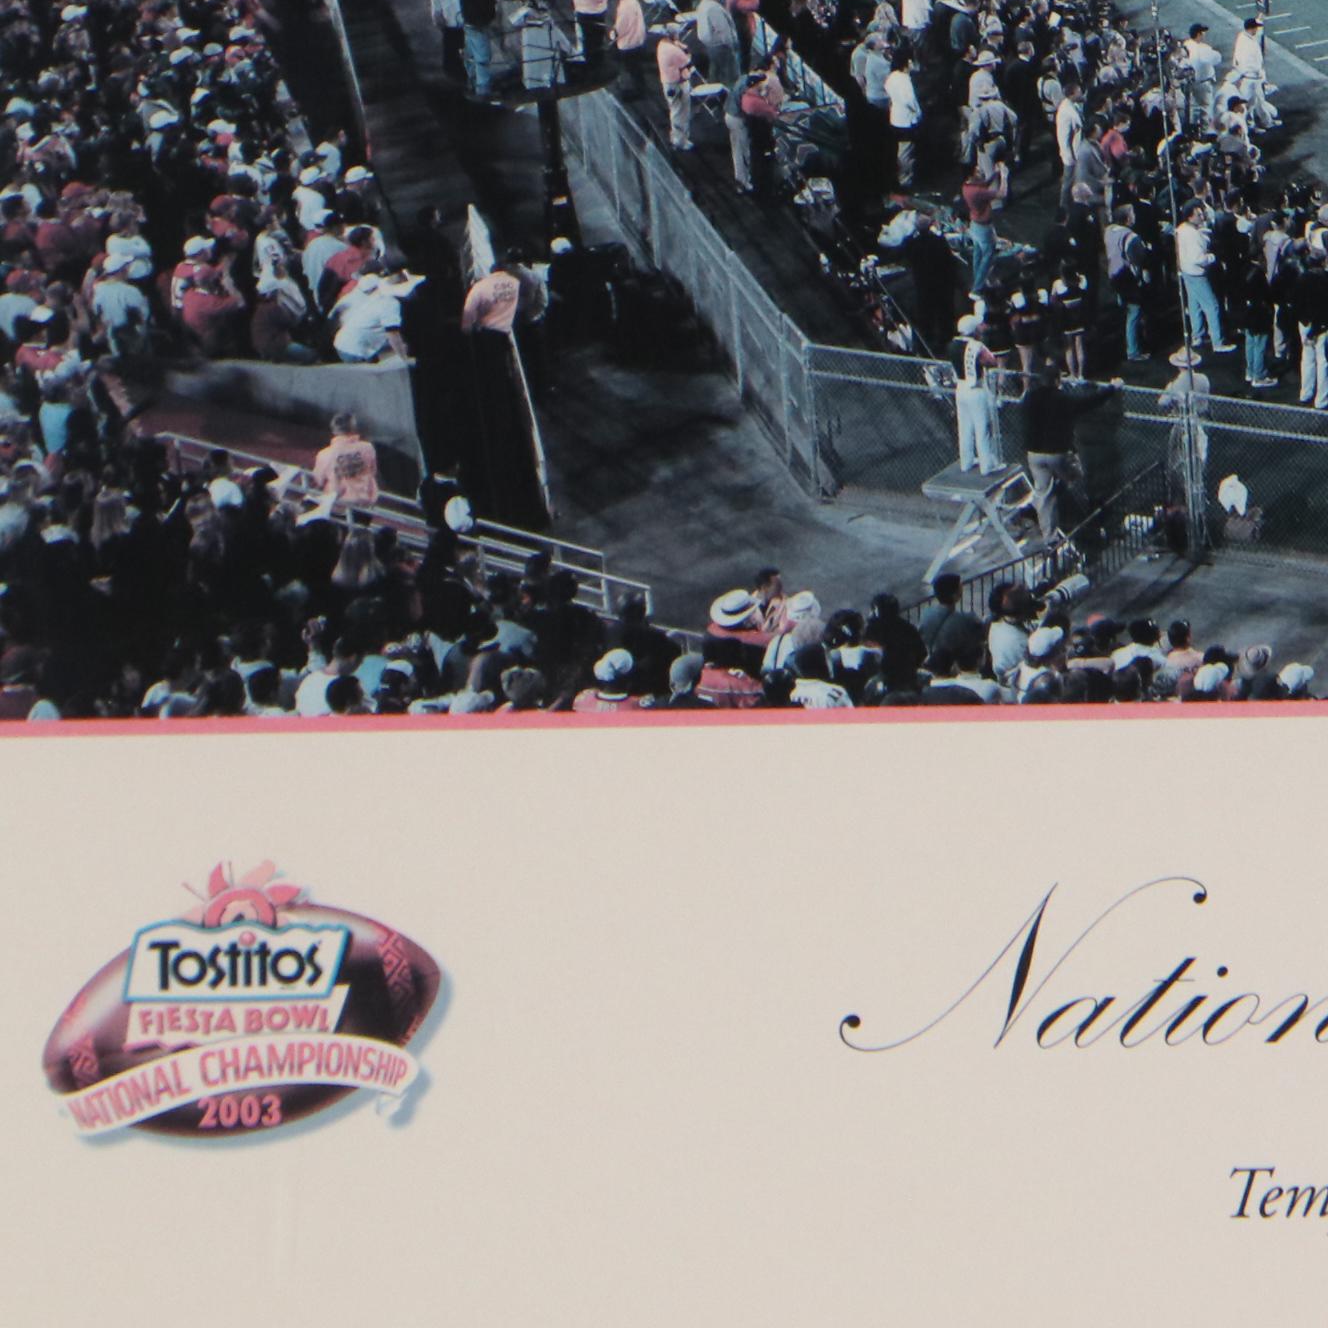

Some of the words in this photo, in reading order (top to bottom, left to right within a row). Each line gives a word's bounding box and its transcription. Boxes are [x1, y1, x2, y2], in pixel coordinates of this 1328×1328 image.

[148, 930, 325, 992] Tostitos
[138, 1005, 237, 1035] FIESTA
[244, 1004, 330, 1034] BOWL
[66, 1069, 191, 1130] NATIONAL
[199, 1041, 409, 1087] CHAMPIONSHIP
[198, 1094, 282, 1128] 2003
